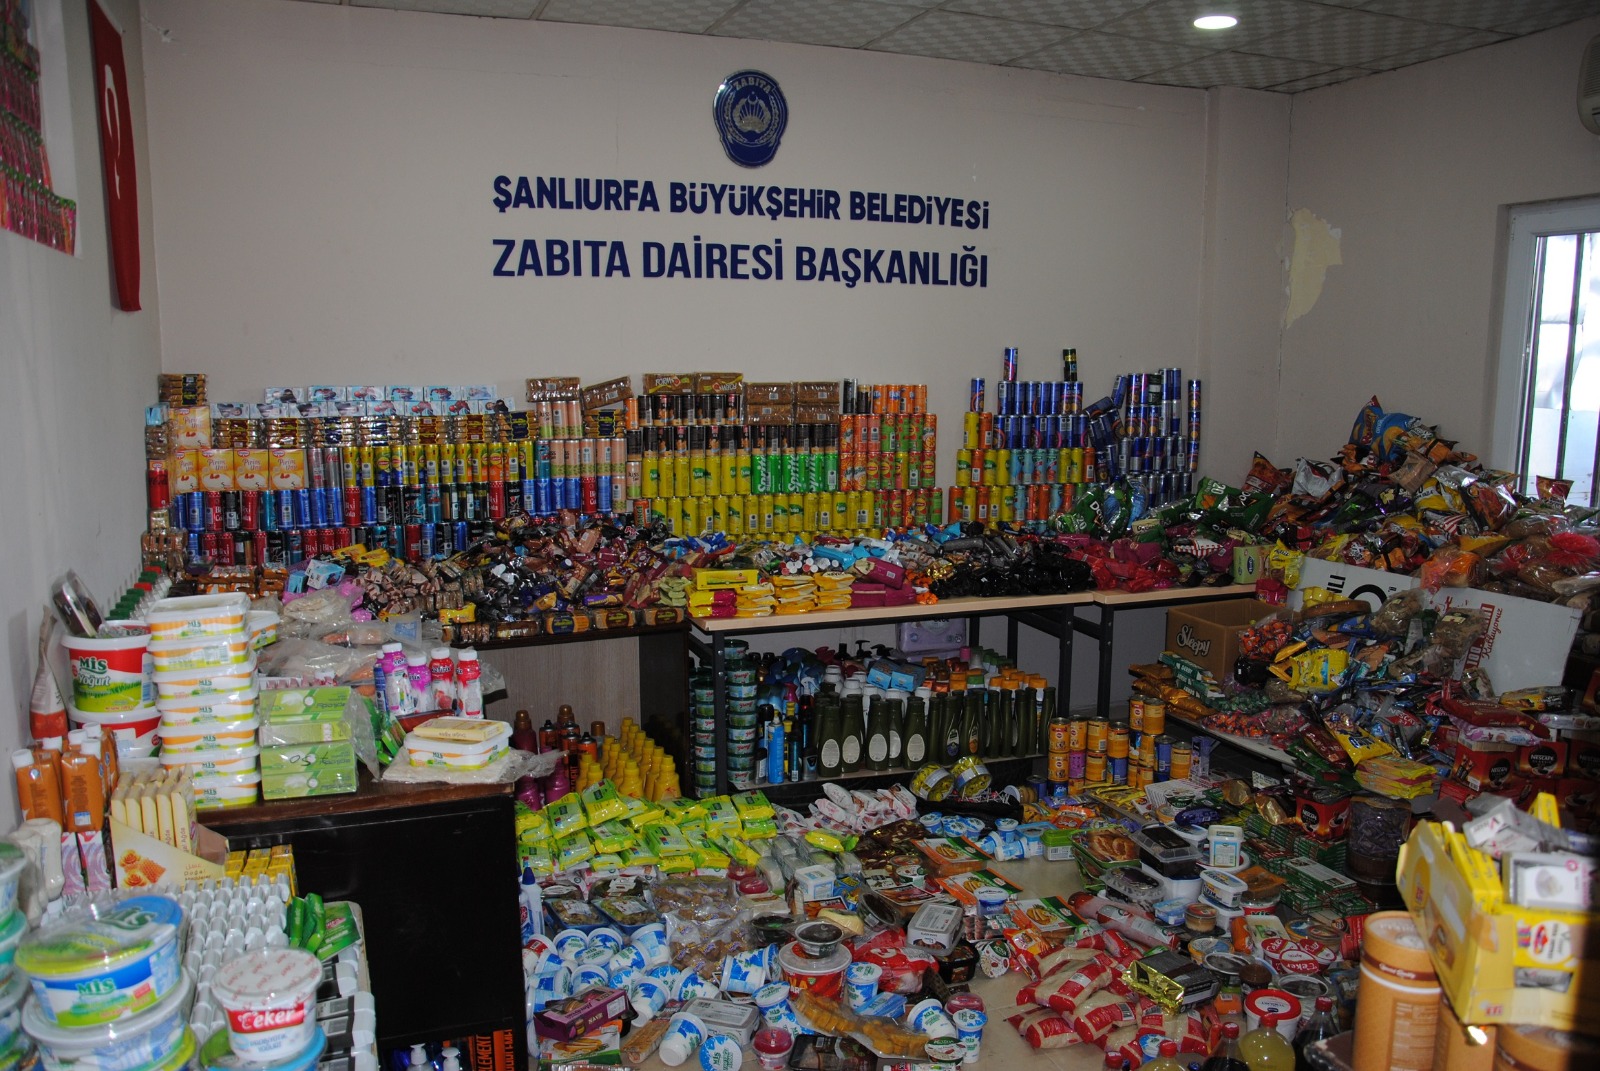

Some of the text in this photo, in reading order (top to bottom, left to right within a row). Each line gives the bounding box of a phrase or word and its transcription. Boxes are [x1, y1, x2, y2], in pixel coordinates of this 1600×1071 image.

[732, 75, 773, 95] ZABITA
[493, 175, 989, 230] ŞANLIURFA BÜYÜKŞEHİR BELEDİYESİ
[492, 235, 988, 288] ZABITA DAİRESİ BAŞKANLIĞI
[788, 454, 801, 493] Sprite
[1176, 624, 1211, 657] Sleepy
[238, 1010, 294, 1030] Eker
